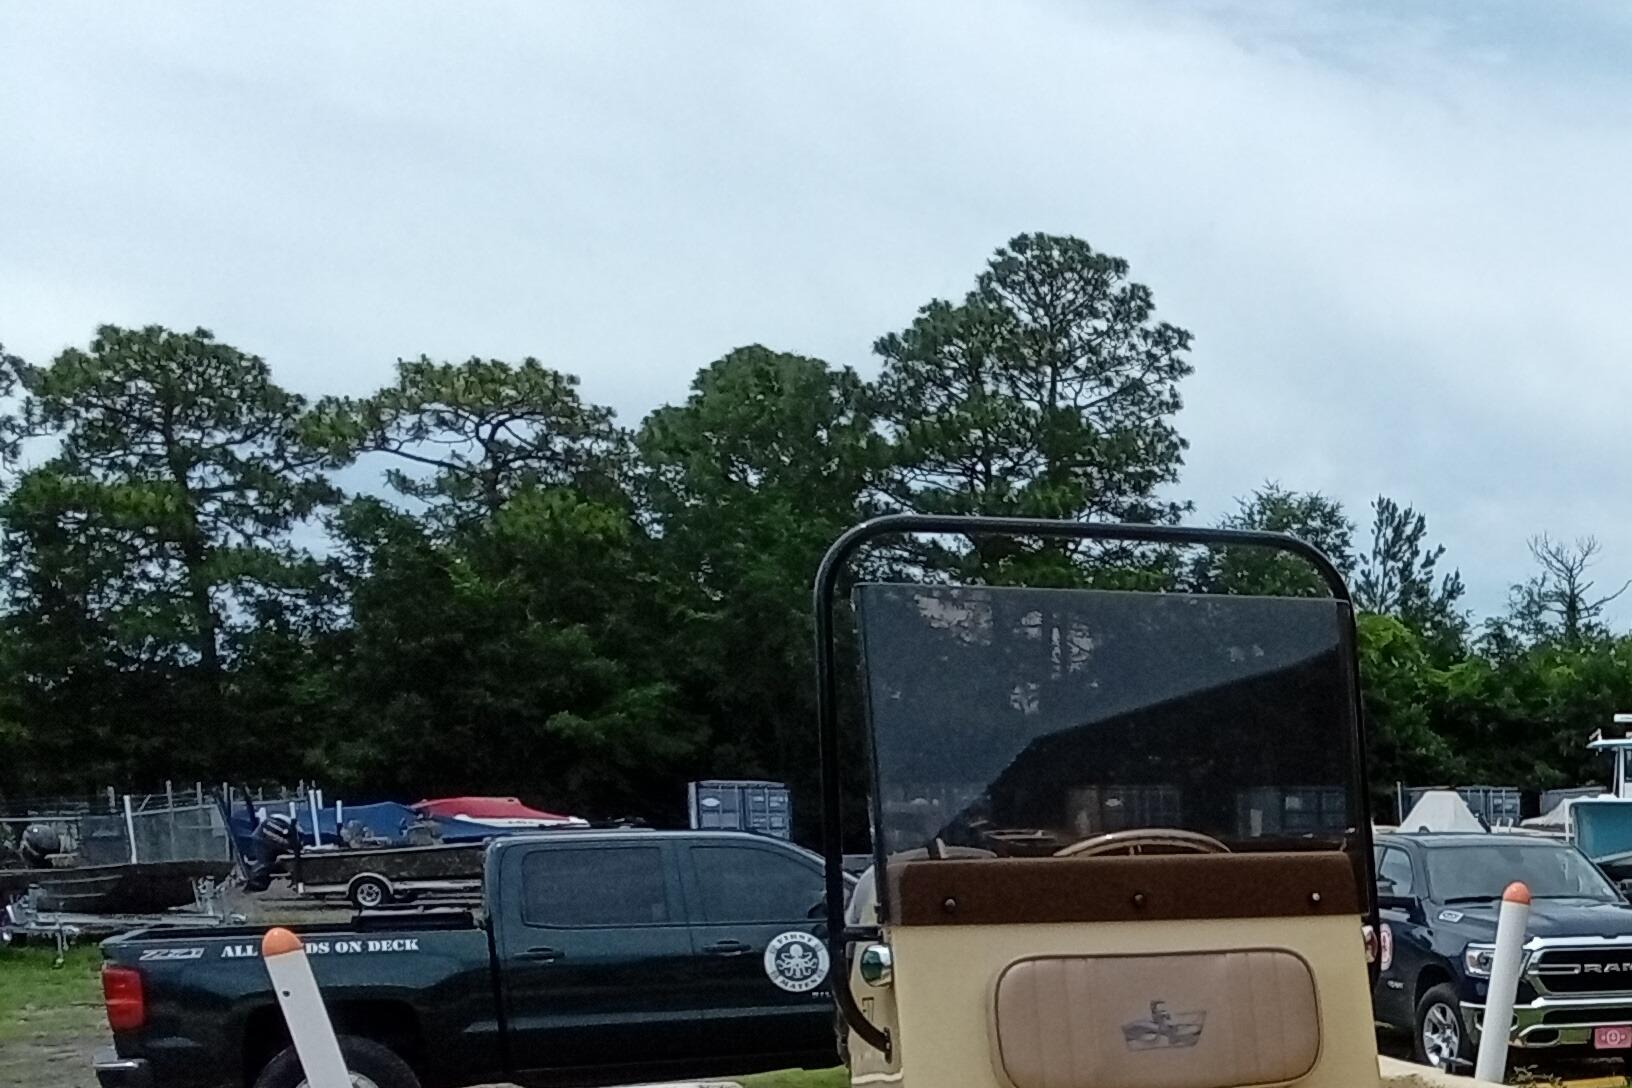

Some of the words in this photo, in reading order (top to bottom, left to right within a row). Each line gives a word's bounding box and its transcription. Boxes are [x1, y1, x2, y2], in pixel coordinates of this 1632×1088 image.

[777, 934, 814, 944] FIRST
[221, 945, 259, 957] ALL
[334, 941, 362, 953] ON
[367, 939, 419, 952] DECK
